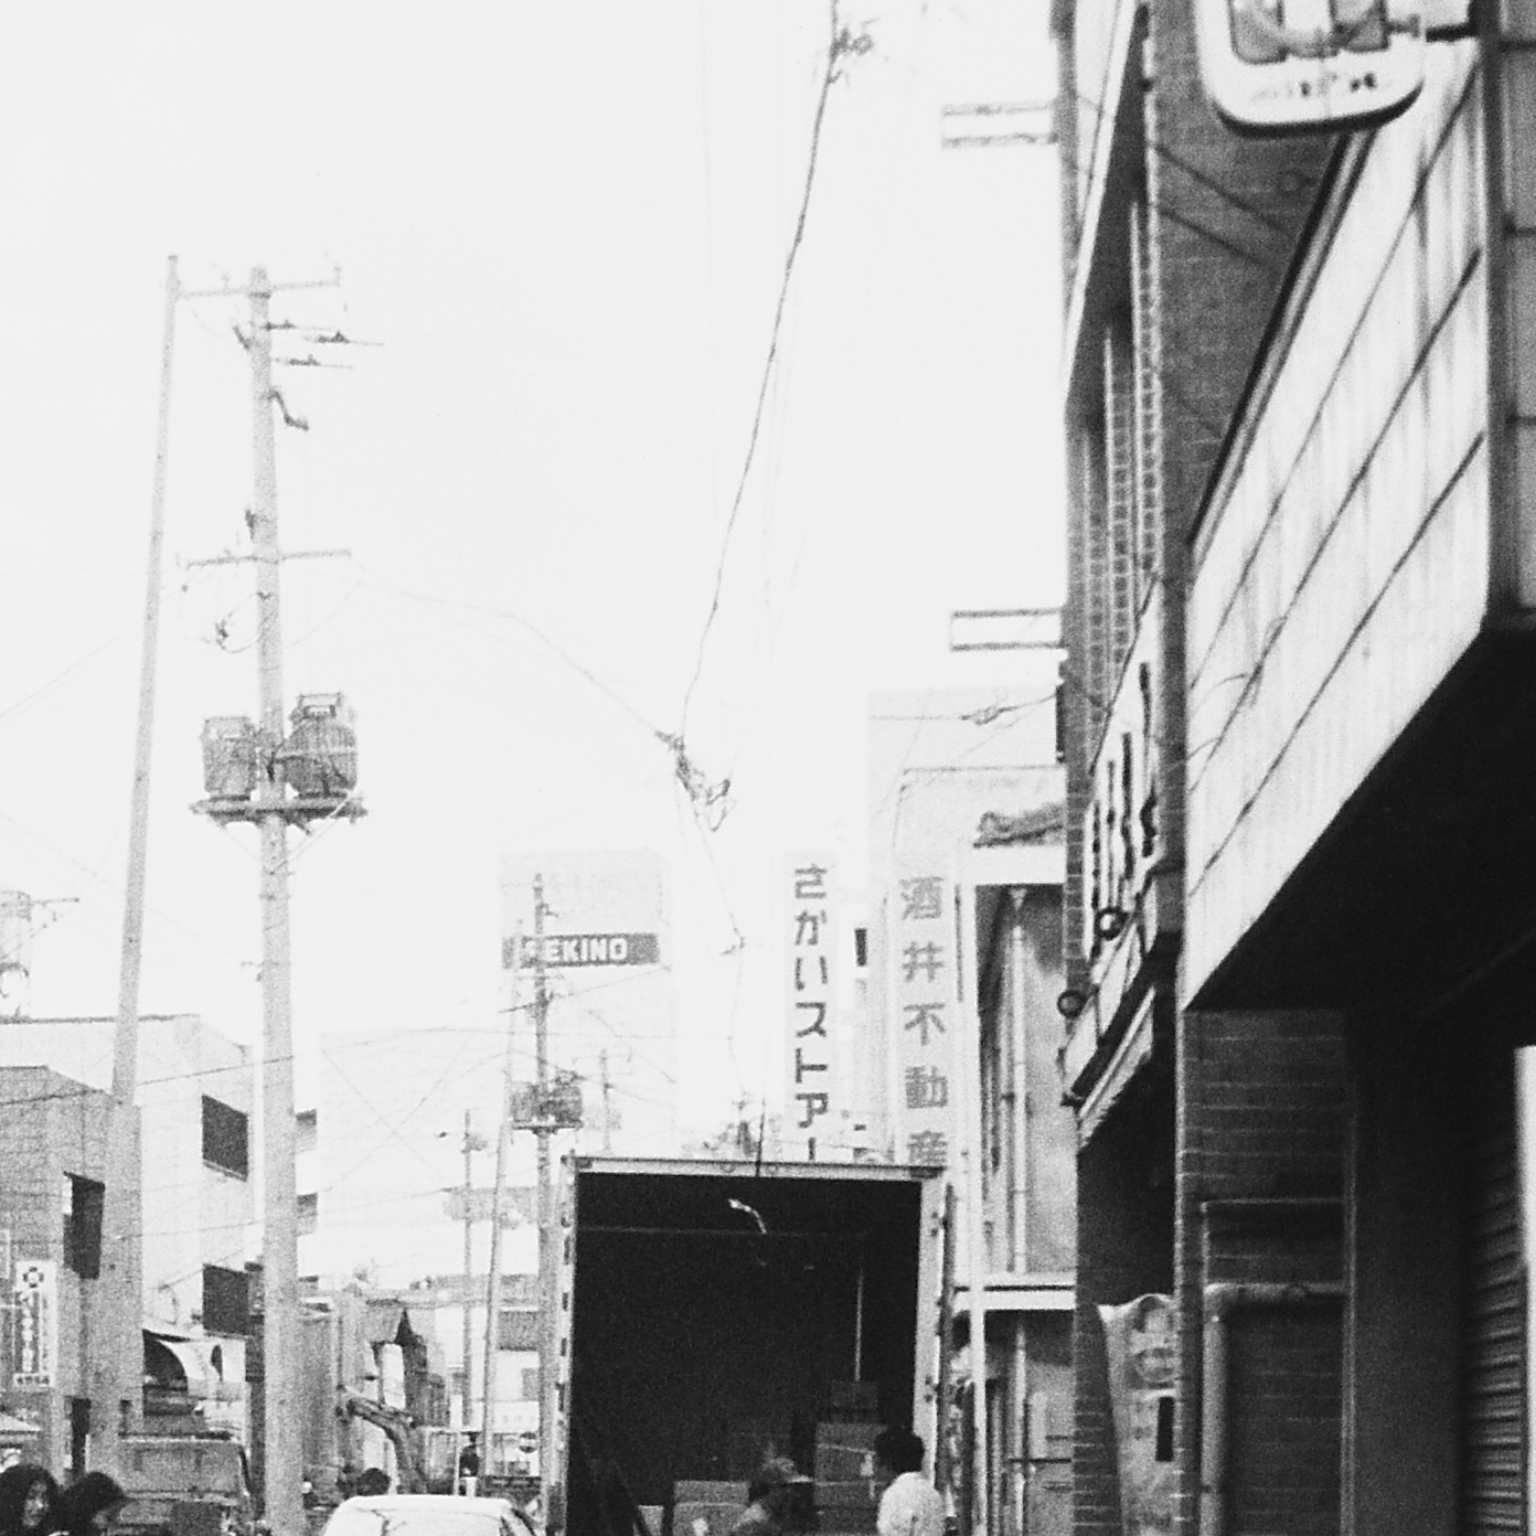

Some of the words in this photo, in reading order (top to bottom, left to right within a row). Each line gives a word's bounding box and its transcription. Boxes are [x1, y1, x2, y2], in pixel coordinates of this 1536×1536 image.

[793, 863, 831, 1161] さかいストアー
[898, 875, 949, 1164] 酒井不動産
